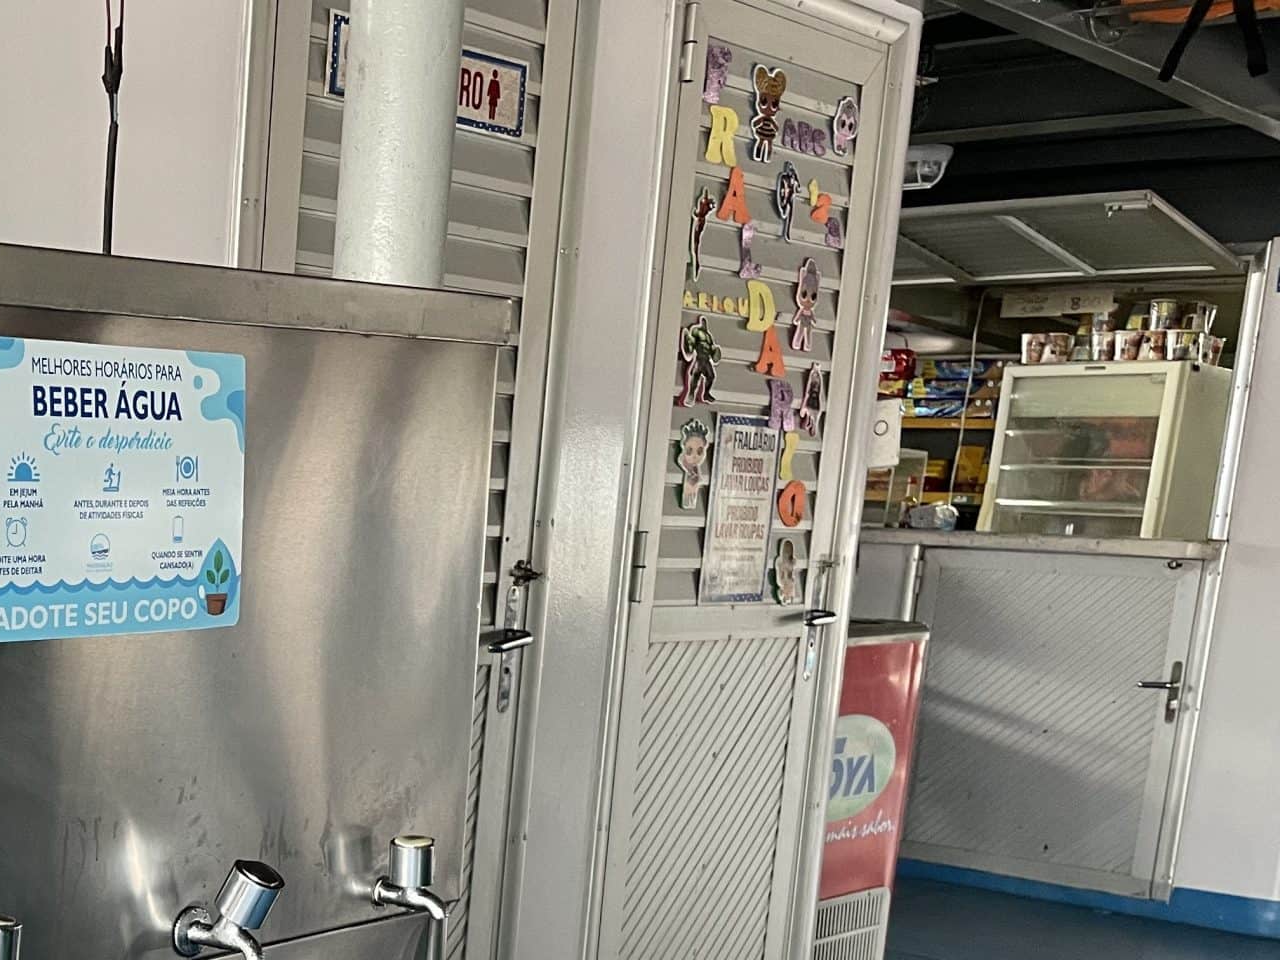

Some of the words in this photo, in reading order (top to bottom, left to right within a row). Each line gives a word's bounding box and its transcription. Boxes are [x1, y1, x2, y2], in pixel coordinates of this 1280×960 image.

[31, 356, 92, 377] MELHORES
[95, 357, 153, 380] HORÁRIOS
[155, 364, 183, 382] PARA
[32, 385, 109, 419] BEBER
[114, 380, 183, 421] ÁGUA
[43, 422, 83, 456] Evite
[9, 488, 19, 497] EM
[19, 487, 38, 498] JEJUM
[176, 488, 192, 496] HORA
[192, 488, 211, 496] ANTES
[3, 499, 19, 508] PELA
[94, 499, 124, 508] DURANTE
[128, 499, 149, 508] DEPOIS
[79, 511, 87, 520] DE
[88, 511, 121, 520] ATIVIDADES
[12, 555, 27, 564] UMA
[28, 554, 46, 563] HORA
[151, 550, 176, 560] QUANDO
[176, 550, 183, 559] SE
[184, 549, 203, 558] SENTIR
[11, 566, 20, 576] DE
[21, 566, 42, 575] DEITAR
[84, 600, 128, 627] SEU
[134, 596, 198, 623] COPO
